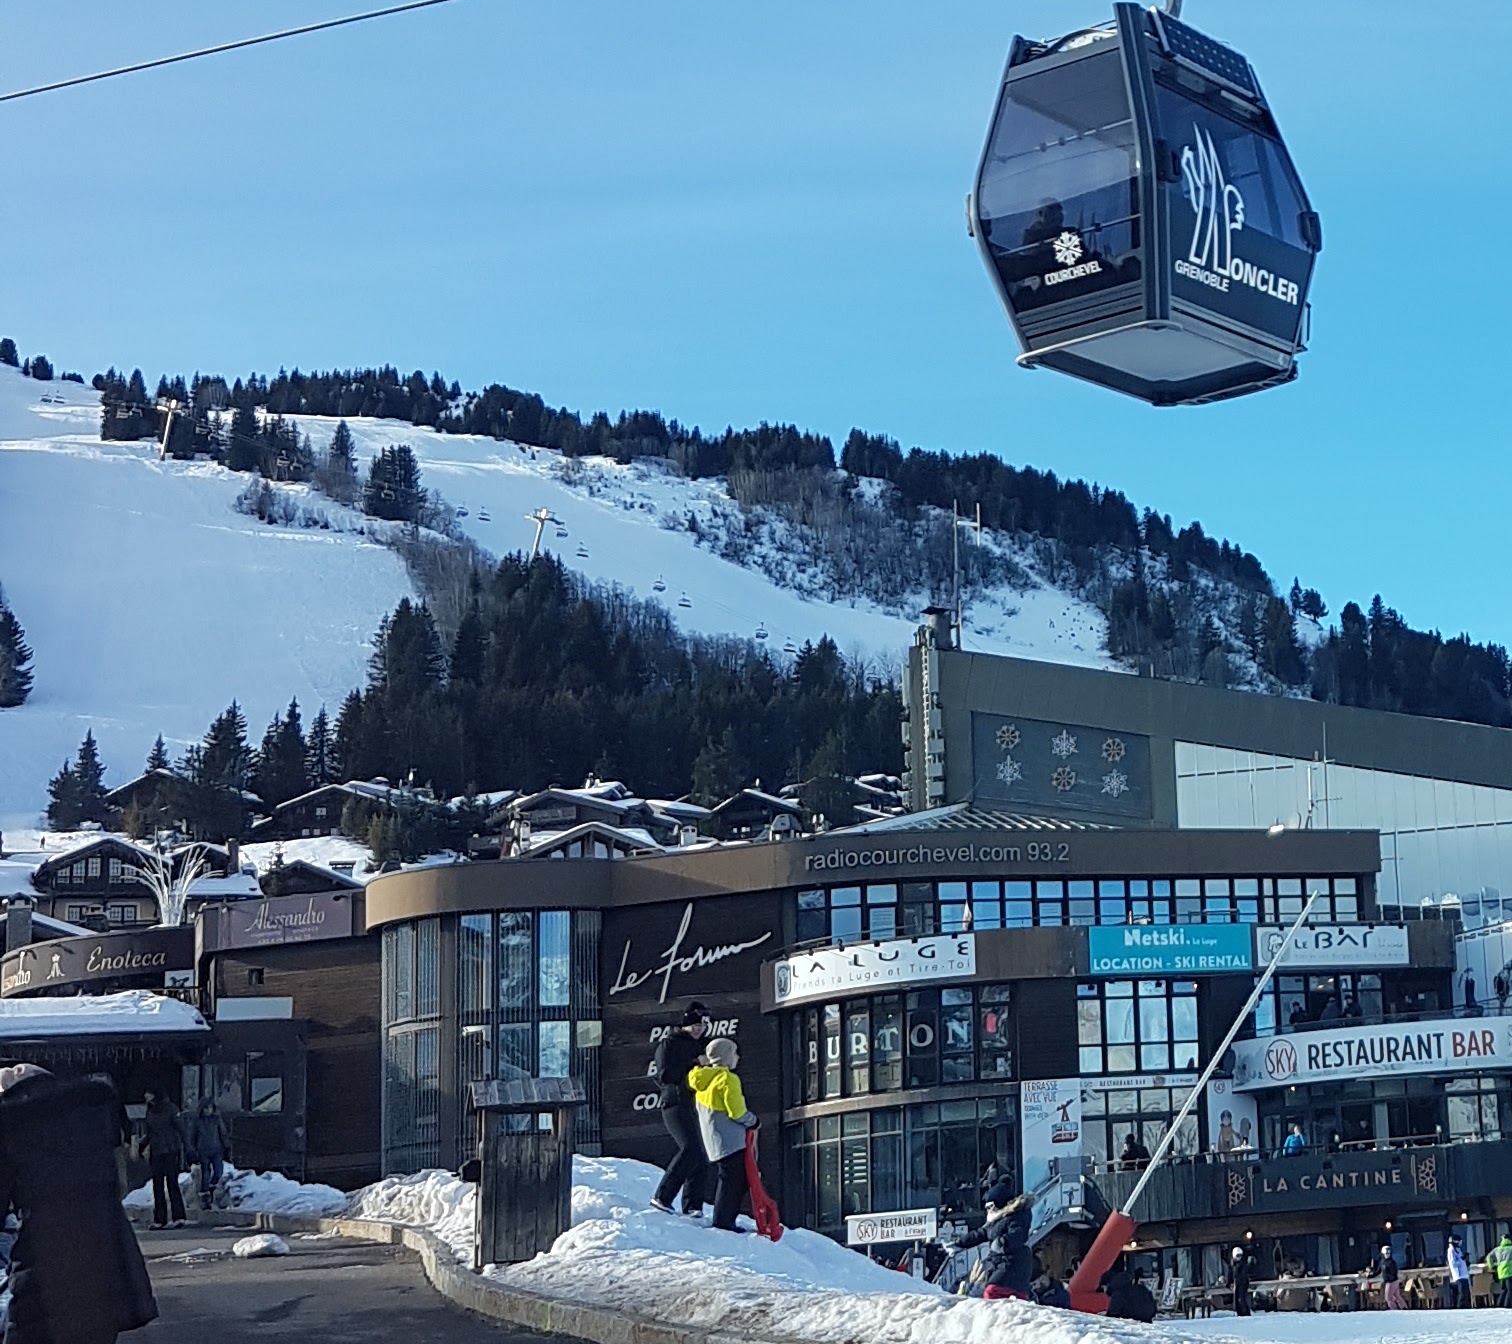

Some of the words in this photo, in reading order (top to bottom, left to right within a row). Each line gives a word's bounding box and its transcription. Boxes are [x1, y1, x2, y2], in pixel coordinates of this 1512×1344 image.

[1044, 260, 1103, 286] COURCHEVEL
[1175, 259, 1230, 292] GRENOBLE
[804, 843, 1021, 871] radiocourchevel.com
[1027, 842, 1070, 862] 93.2
[245, 897, 325, 931] Alessandro
[86, 945, 166, 973] Enoteca
[609, 939, 652, 995] Le
[654, 902, 772, 1004] Forum
[852, 940, 969, 967] LUGE
[1093, 957, 1163, 971] LOCATION
[1175, 956, 1196, 969] SKI
[1199, 955, 1249, 968] RENTAL
[849, 970, 880, 982] Luge
[809, 1019, 971, 1064] BURTON
[1267, 1046, 1294, 1074] SKY
[1307, 1032, 1446, 1070] RESTAURANT
[1451, 1029, 1496, 1059] BAR
[1263, 1177, 1289, 1194] LA
[1300, 1169, 1402, 1191] CANTINE
[858, 1221, 877, 1239] SKY
[880, 1215, 928, 1229] RESTAURANT
